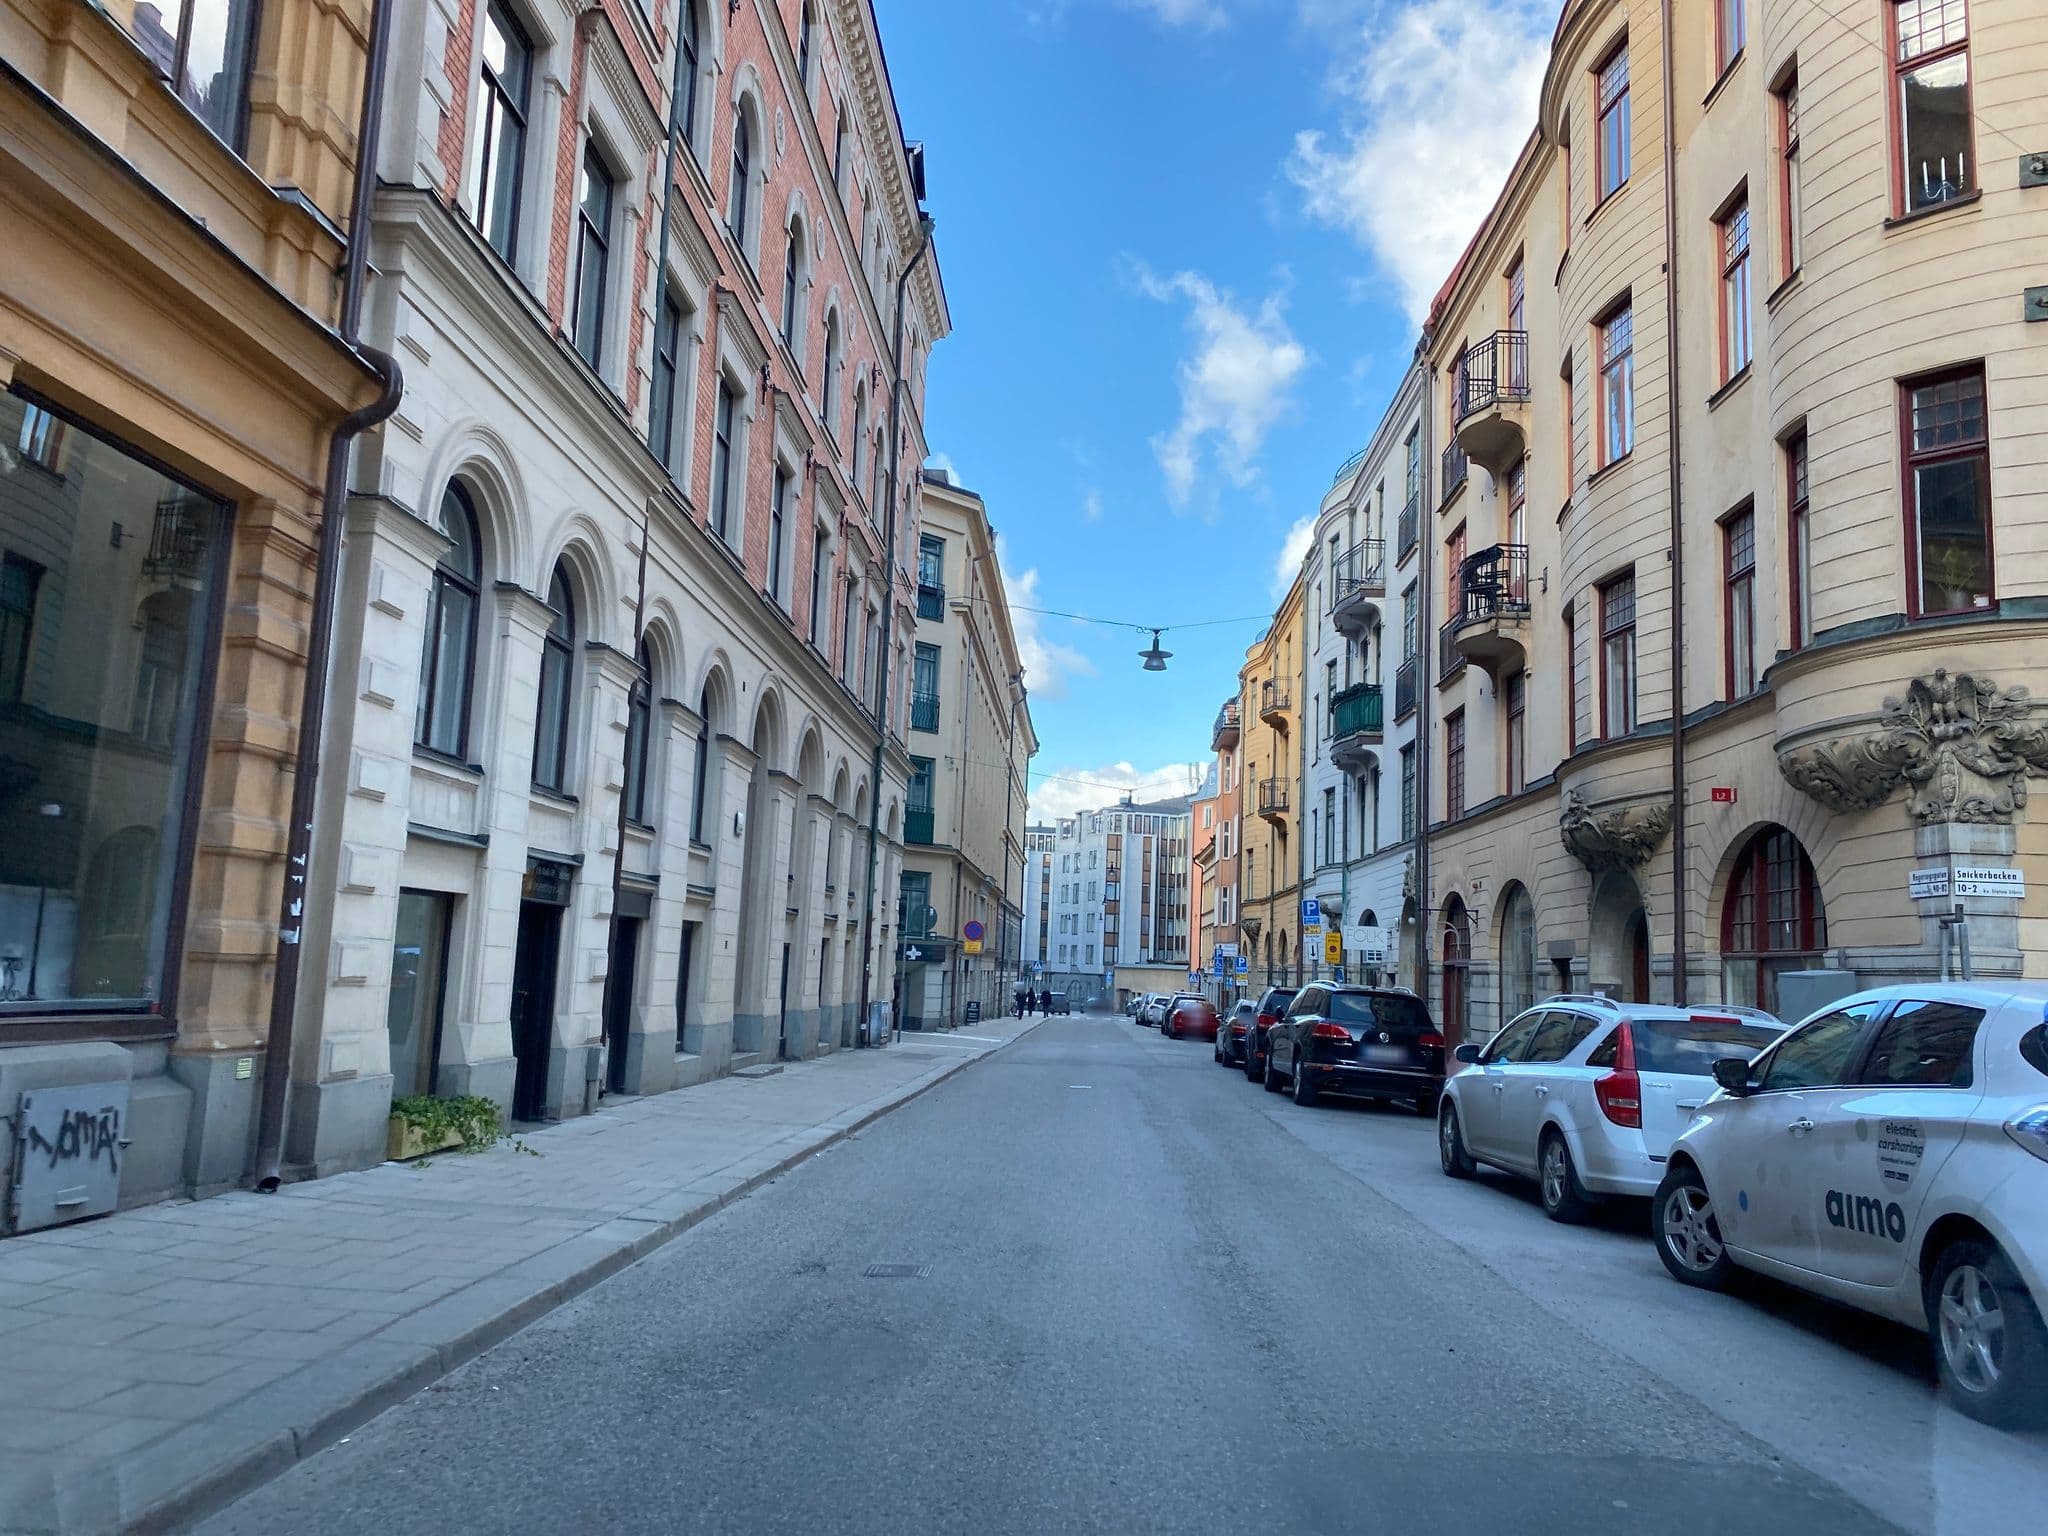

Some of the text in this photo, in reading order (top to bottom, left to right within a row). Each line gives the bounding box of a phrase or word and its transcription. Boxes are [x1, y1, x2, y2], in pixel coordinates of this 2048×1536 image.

[1957, 870, 2017, 880] Snickarbacken
[1958, 884, 1978, 893] 10-2
[1346, 927, 1386, 944] FOLK
[1885, 1122, 1918, 1138] electric
[1878, 1139, 1924, 1158] carsharing
[1825, 1189, 1906, 1243] aimo
